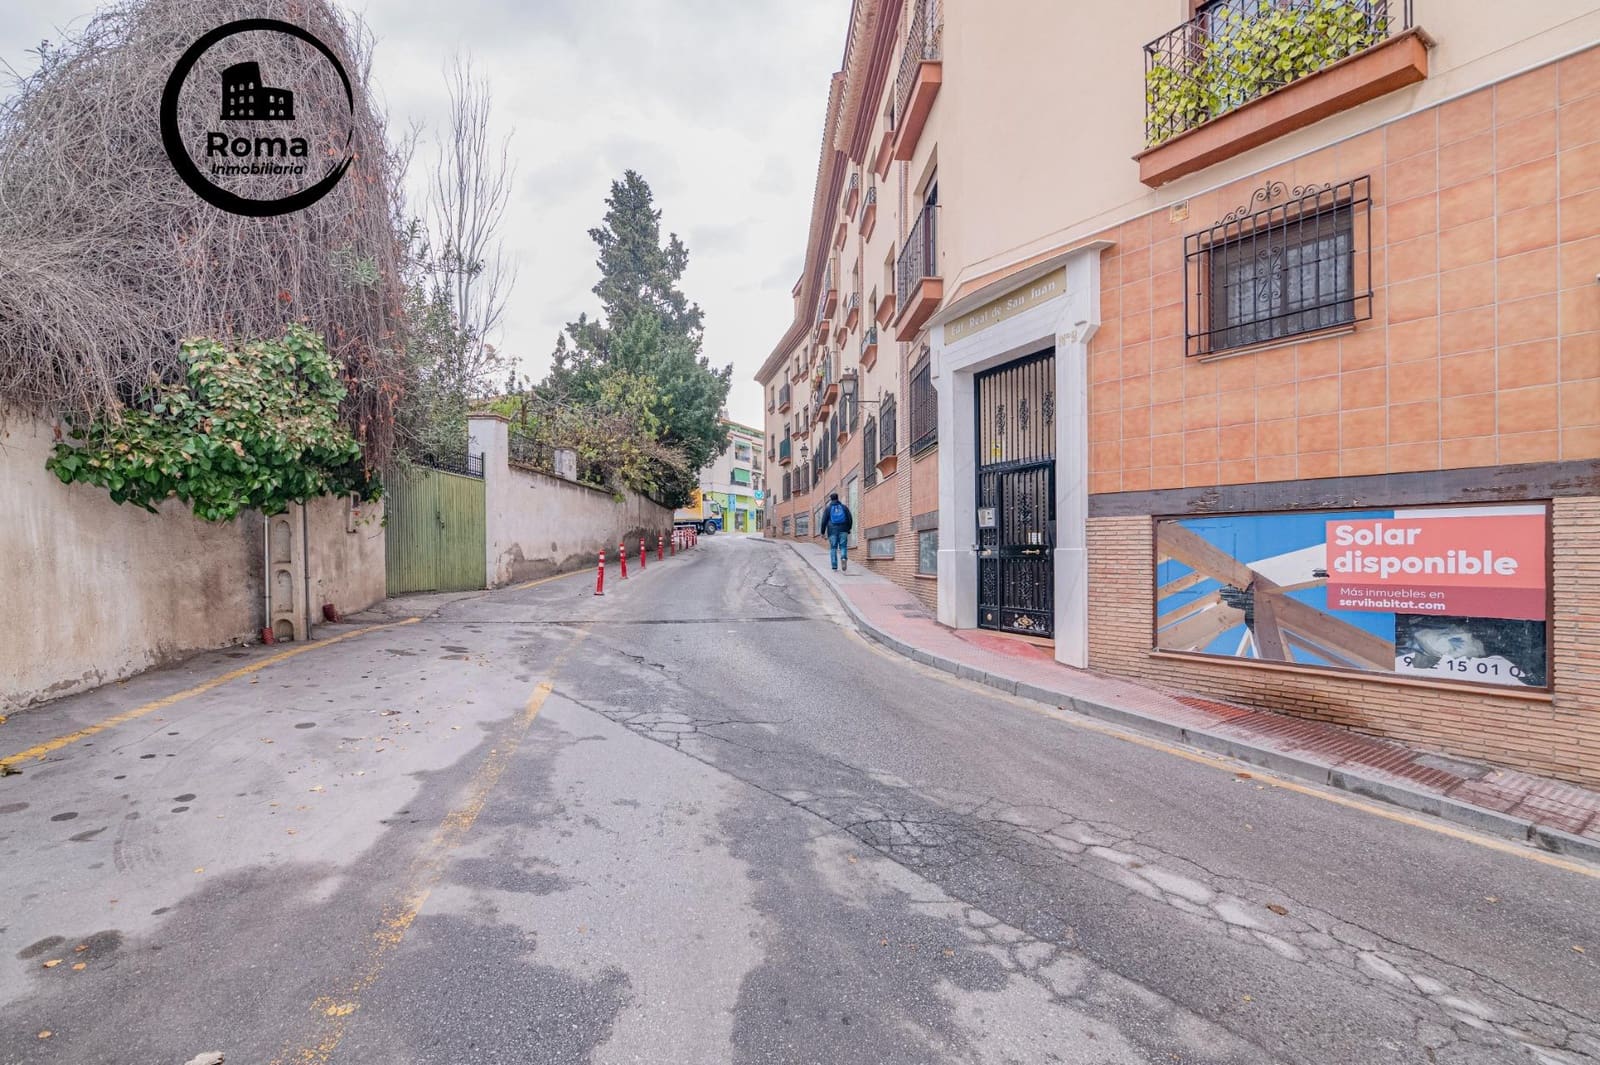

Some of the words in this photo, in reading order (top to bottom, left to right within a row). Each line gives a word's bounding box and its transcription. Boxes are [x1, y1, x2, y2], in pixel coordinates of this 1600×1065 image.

[1006, 296, 1025, 311] San
[1031, 281, 1056, 299] Juan
[1335, 523, 1422, 546] Solar
[1334, 550, 1519, 579] disponible
[1340, 587, 1364, 597] Más
[1366, 588, 1426, 599] inmuebles
[1429, 591, 1445, 599] en
[1339, 598, 1446, 610] servihabitat.com
[1447, 660, 1467, 672] 15
[1476, 663, 1499, 676] 01
